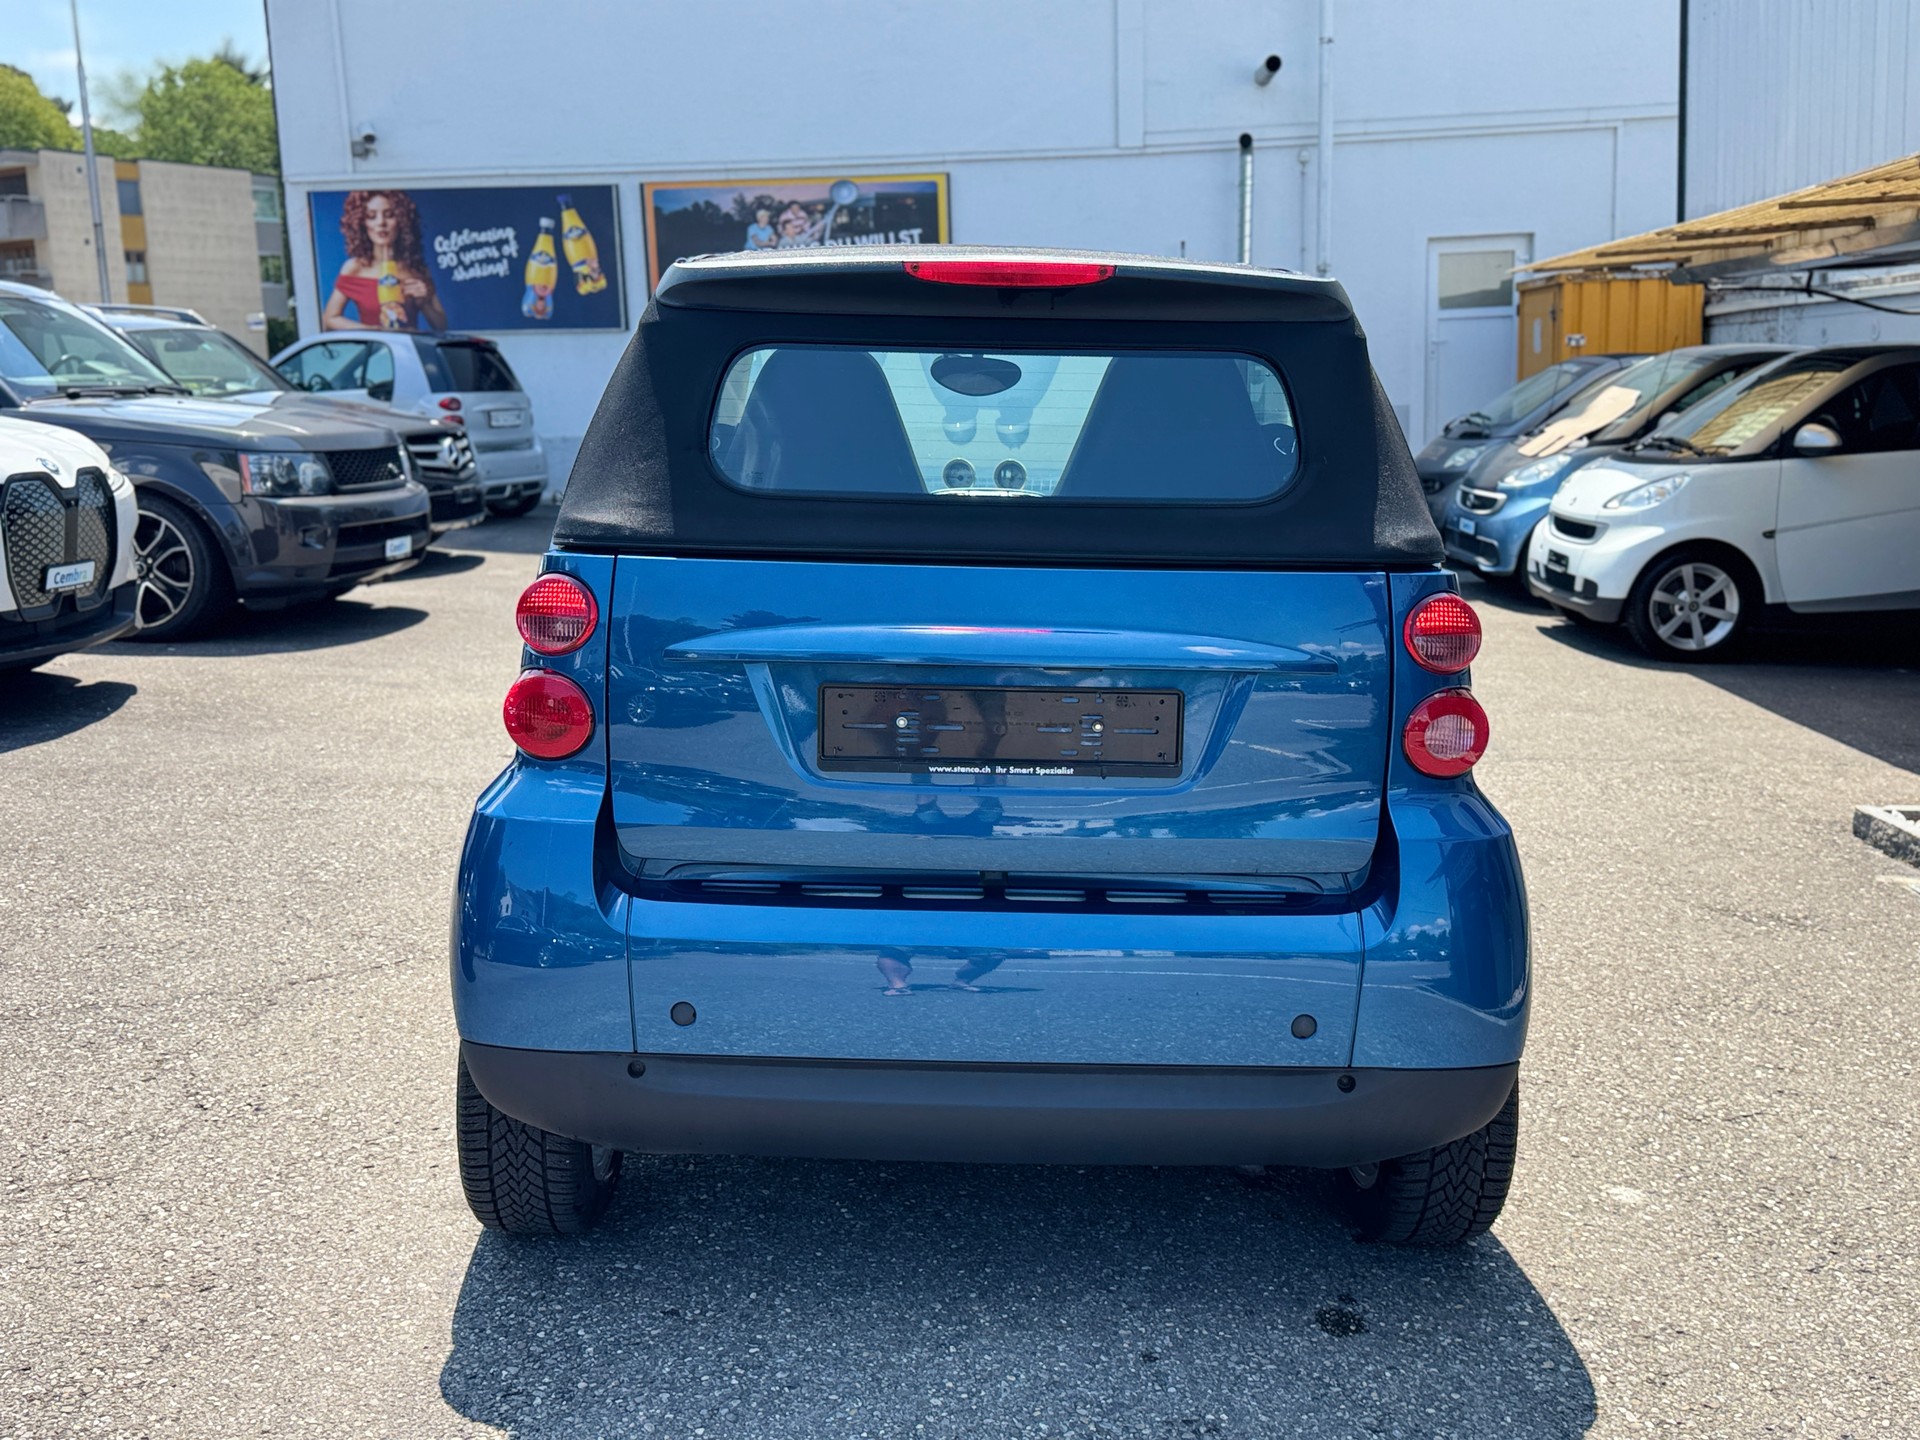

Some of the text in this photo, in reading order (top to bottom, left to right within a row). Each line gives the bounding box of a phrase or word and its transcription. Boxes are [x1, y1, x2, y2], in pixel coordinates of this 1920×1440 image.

[437, 238, 518, 269] 90 years of
[451, 258, 510, 281] shaking!
[54, 568, 88, 585] Cembra
[928, 765, 1074, 777] www.stanco.ch ihr Smart Spezialist
